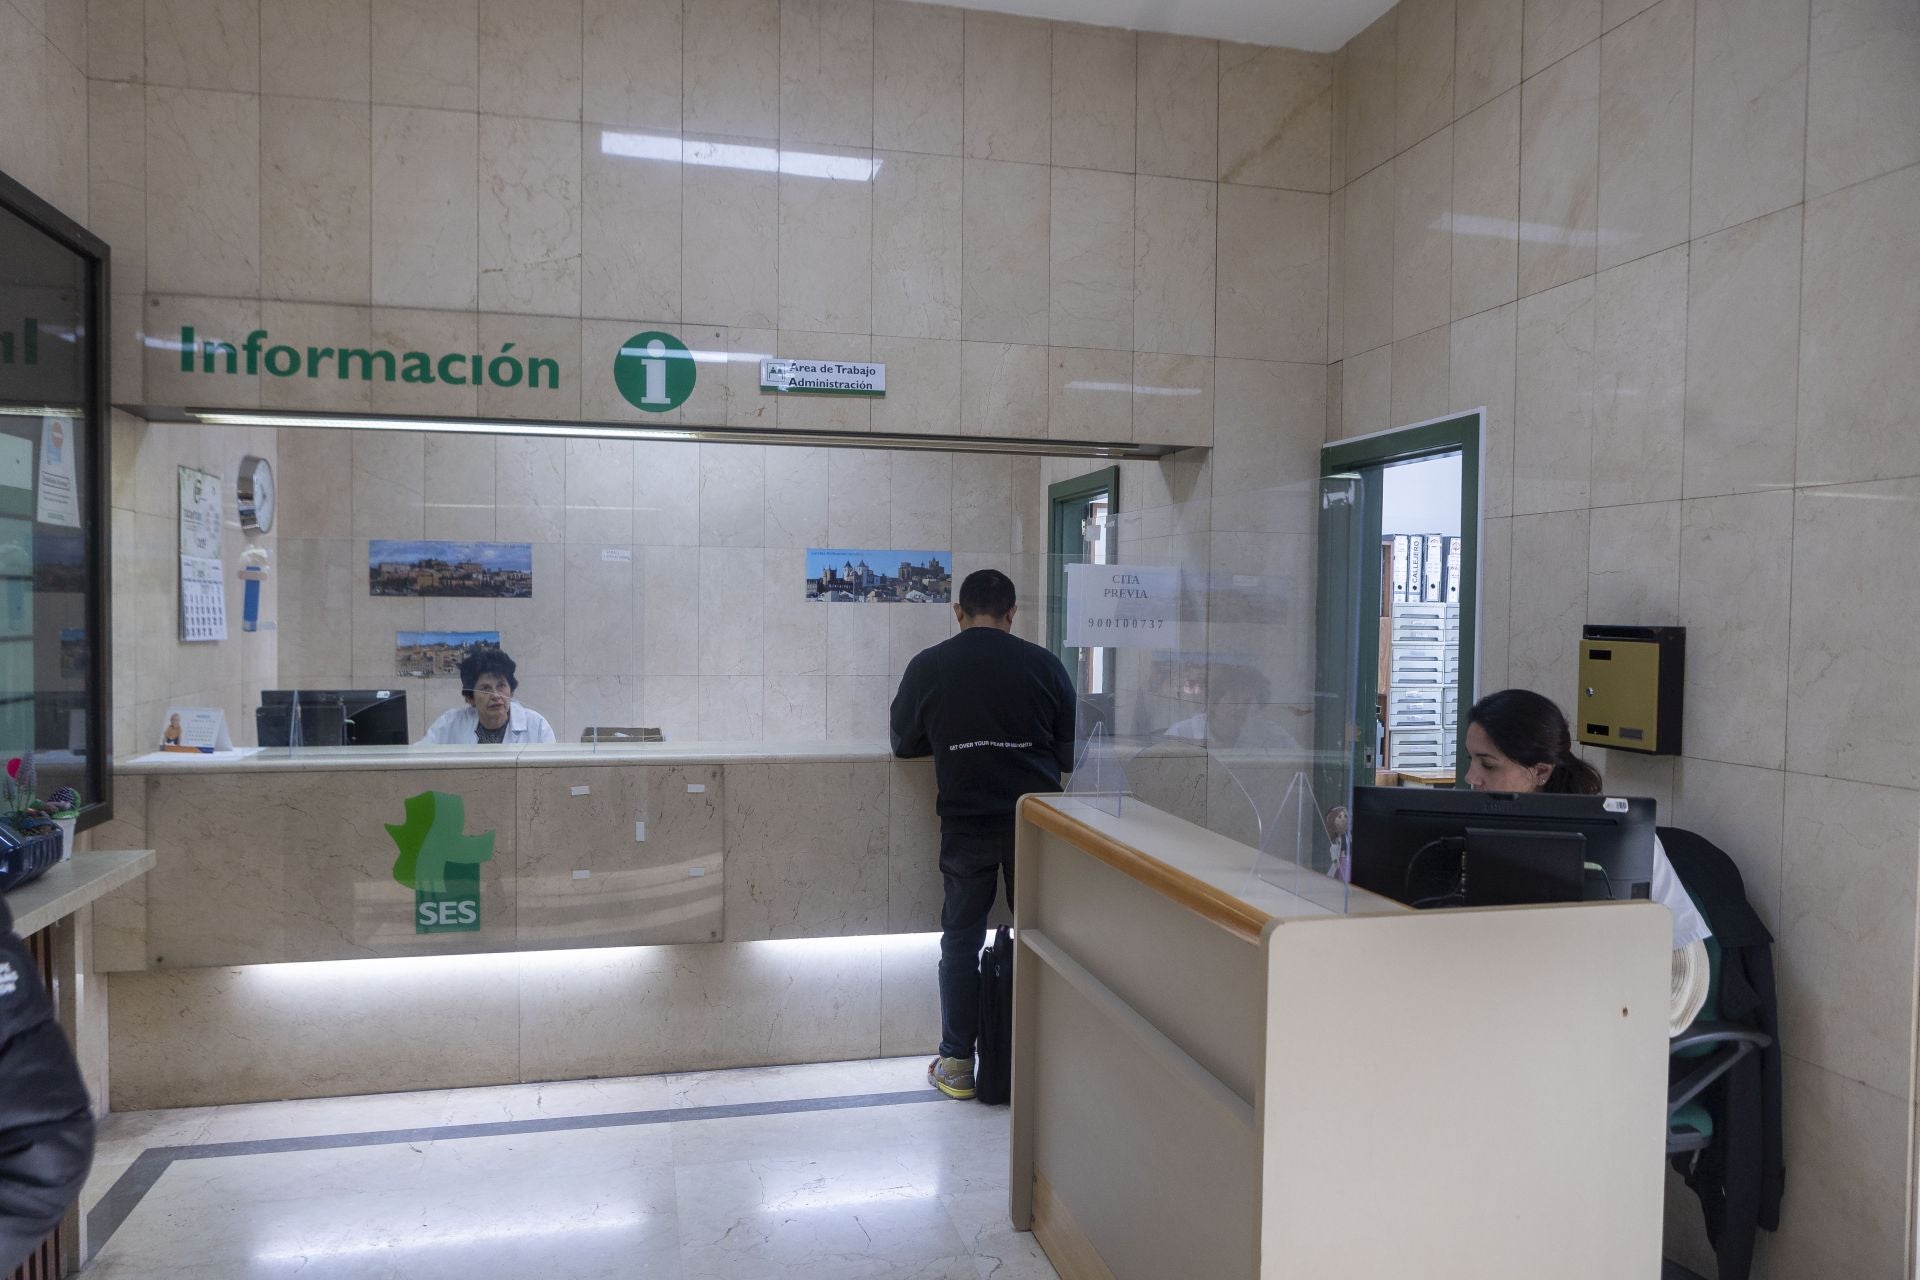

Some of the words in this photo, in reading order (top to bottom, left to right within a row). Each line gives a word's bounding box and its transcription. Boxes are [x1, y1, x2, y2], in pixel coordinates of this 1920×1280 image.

[180, 325, 560, 390] Información
[820, 364, 834, 374] de
[834, 364, 876, 378] Trabajo
[788, 377, 873, 390] Administración
[1411, 540, 1420, 584] CALLEJERO
[1112, 574, 1140, 585] CITA
[1103, 588, 1148, 599] PREVIA
[1088, 617, 1164, 629] 900100737
[418, 900, 477, 926] SES
